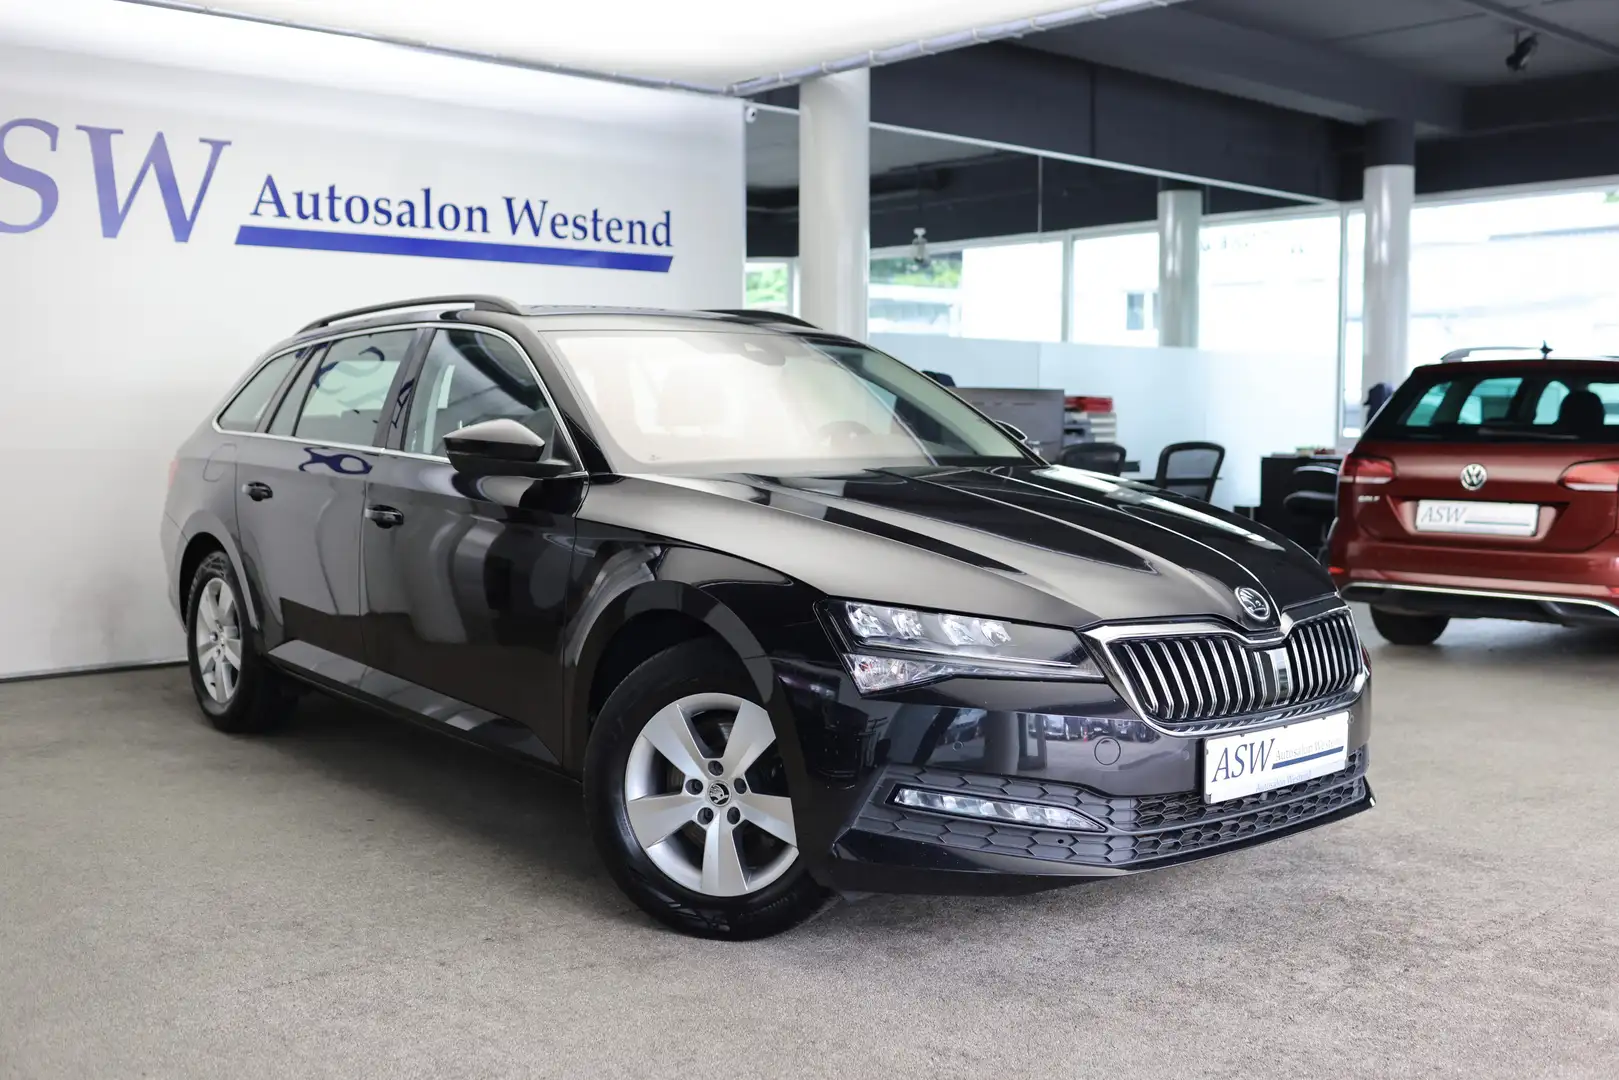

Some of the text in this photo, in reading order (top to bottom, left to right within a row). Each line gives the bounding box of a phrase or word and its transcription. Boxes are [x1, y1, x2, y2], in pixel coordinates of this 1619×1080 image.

[0, 118, 673, 247] SW Autosalon Westend
[1421, 507, 1467, 523] ASW
[1212, 738, 1275, 783] ASW
